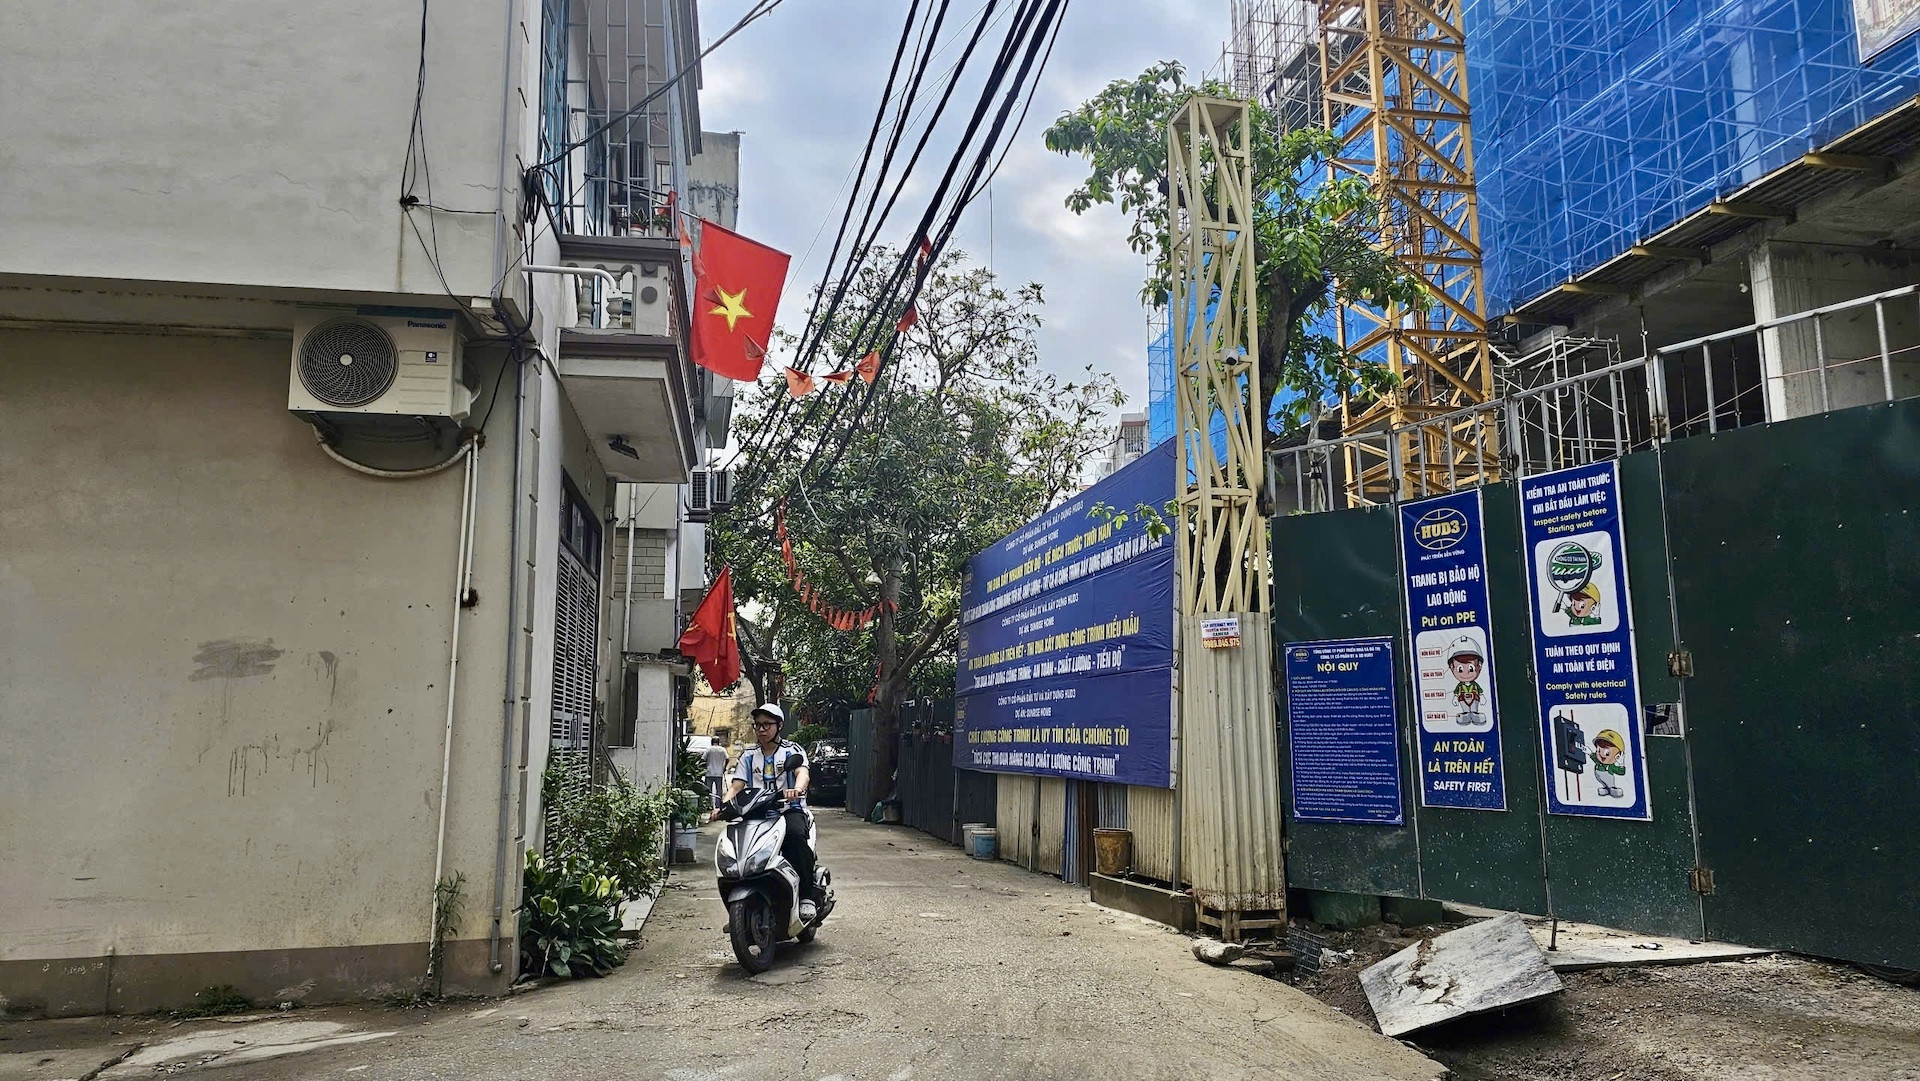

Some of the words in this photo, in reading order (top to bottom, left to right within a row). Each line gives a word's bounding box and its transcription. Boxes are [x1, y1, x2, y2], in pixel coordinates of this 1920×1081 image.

[408, 320, 446, 328] Panasonic
[1544, 484, 1556, 496] TRA
[1558, 482, 1568, 494] AN
[1568, 478, 1586, 492] TOÀN
[1587, 472, 1610, 487] TRƯỚC
[1532, 502, 1544, 514] KHI
[1574, 494, 1588, 506] LÀM
[1590, 490, 1606, 504] VIỆC
[1534, 516, 1559, 526] Inspect
[1560, 512, 1581, 522] safety
[1548, 524, 1575, 534] Starting
[1576, 520, 1594, 528] work
[1421, 520, 1460, 539] HUD3
[1411, 572, 1437, 588] TRANG
[1438, 571, 1447, 586] BỊ
[1449, 565, 1466, 583] BẢO
[1468, 564, 1480, 582] HỘ
[1427, 593, 1442, 607] LAO
[1443, 588, 1466, 606] ĐỘNG
[1422, 616, 1437, 627] Put
[1440, 616, 1453, 625] on
[1456, 611, 1476, 624] PPE
[1070, 627, 1086, 646] CÔNG
[1087, 623, 1105, 643] TRÌNH
[1545, 645, 1564, 658] TUÂN
[1565, 645, 1583, 656] THEO
[1585, 644, 1599, 655] QUY
[1602, 642, 1620, 655] ĐỊNH
[1072, 654, 1091, 675] LƯỢNG
[1096, 646, 1111, 669] TIẾN
[1317, 661, 1335, 674] NỘI
[1338, 662, 1359, 671] QUY
[1553, 663, 1563, 673] AN
[1565, 660, 1584, 672] TOÀN
[1596, 658, 1615, 672] ĐIỆN
[1591, 680, 1626, 688] electrical
[998, 726, 1012, 743] CÔNG
[1013, 725, 1030, 742] TRÌNH
[1031, 725, 1040, 743] LÀ
[1041, 728, 1050, 743] UY
[1052, 725, 1064, 744] TÍN
[1065, 722, 1080, 744] CỦA
[1083, 724, 1112, 745] CHÚNG
[1114, 724, 1129, 746] TÔI
[1433, 741, 1450, 752] AN
[1453, 738, 1484, 752] TOÀN
[1024, 752, 1034, 767] CAO
[1035, 749, 1050, 768] CHẤT
[1051, 753, 1072, 773] LƯỢNG
[1072, 752, 1091, 773] CÔNG
[1428, 758, 1441, 772] LÀ
[1444, 759, 1470, 773] TRÊN
[1474, 757, 1495, 774] HẾT
[1433, 780, 1465, 791] SAFETY
[1467, 782, 1492, 792] FIRST
